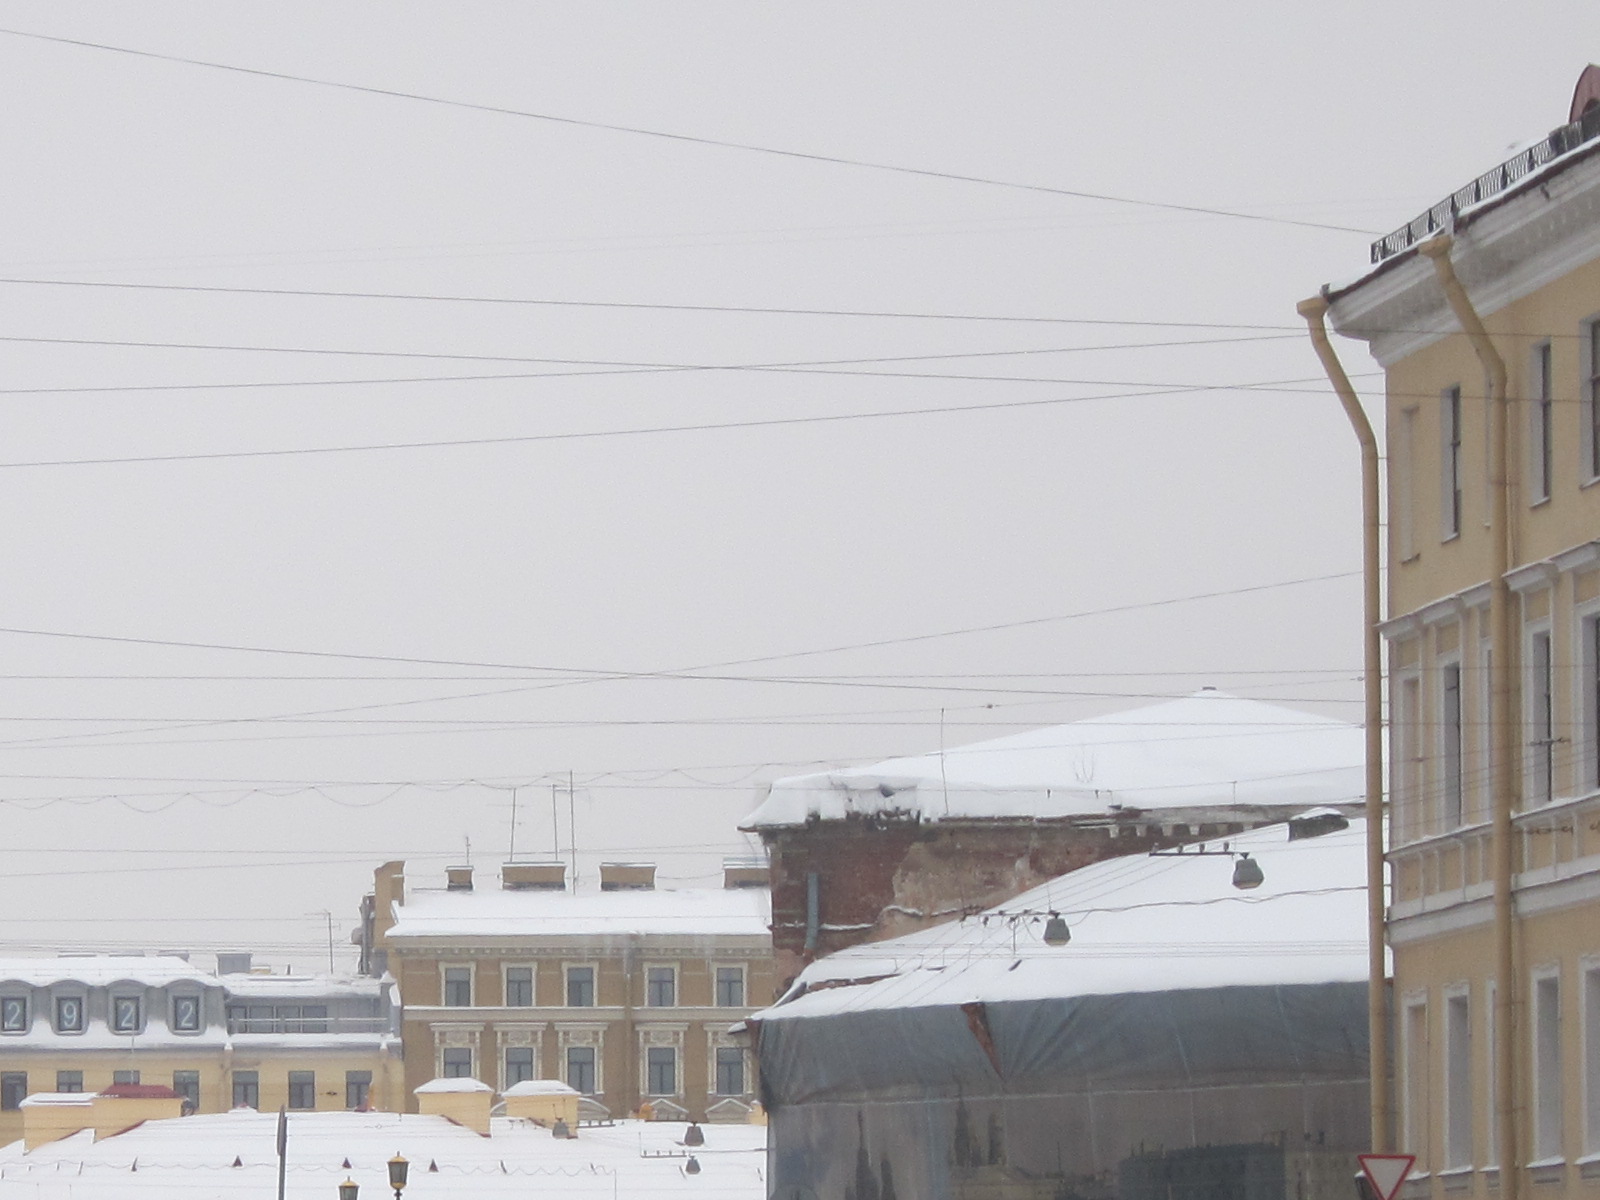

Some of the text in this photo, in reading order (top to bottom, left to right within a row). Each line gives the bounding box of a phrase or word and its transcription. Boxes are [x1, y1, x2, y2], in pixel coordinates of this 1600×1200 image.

[8, 1002, 21, 1028] 2
[63, 1002, 77, 1028] 9
[121, 1003, 135, 1028] 2
[180, 1002, 193, 1027] 2
